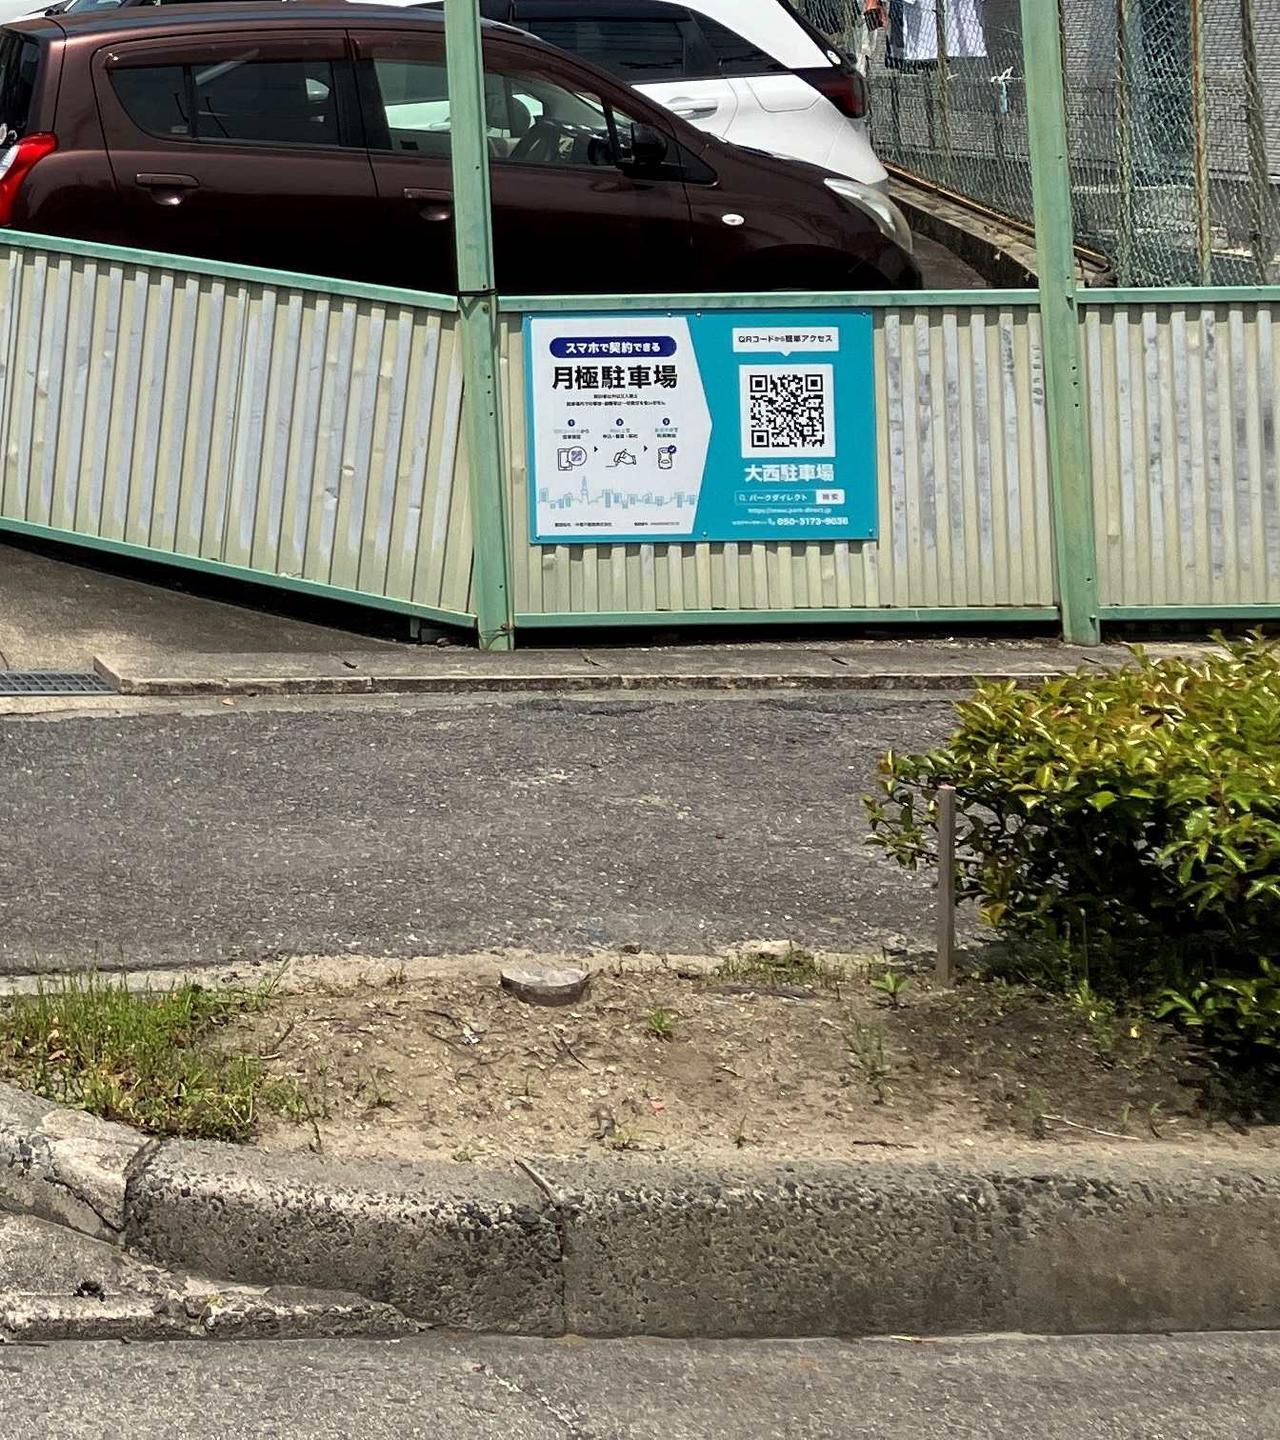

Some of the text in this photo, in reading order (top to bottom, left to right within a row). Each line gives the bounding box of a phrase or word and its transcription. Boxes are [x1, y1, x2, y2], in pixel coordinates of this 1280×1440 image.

[565, 341, 660, 354] スマホで契約できる
[552, 364, 678, 390] 月極駐車場
[744, 463, 835, 482] 大西駐車場
